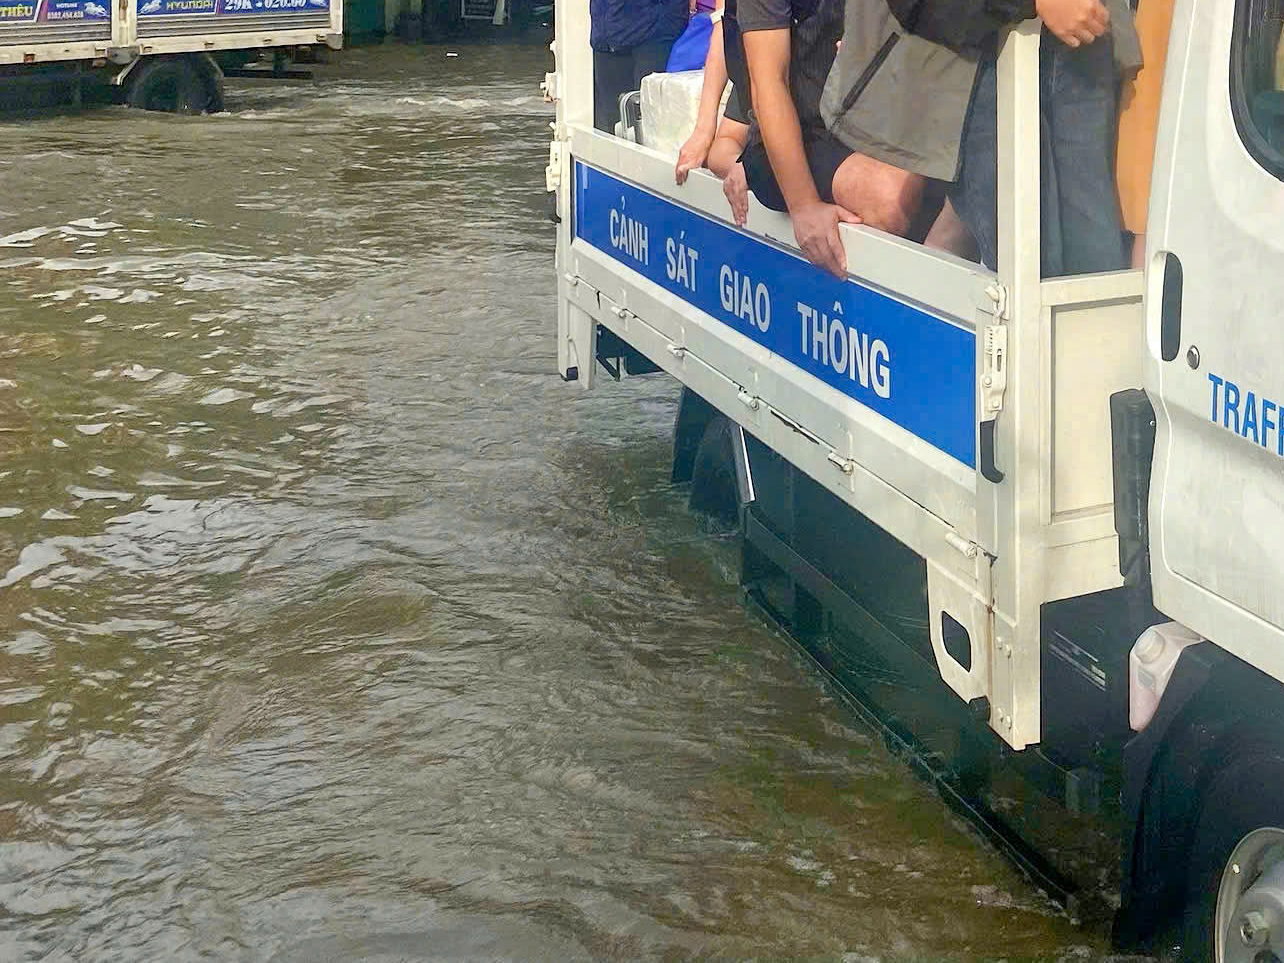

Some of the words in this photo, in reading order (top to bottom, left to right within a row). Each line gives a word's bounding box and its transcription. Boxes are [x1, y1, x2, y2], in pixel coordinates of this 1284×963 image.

[609, 196, 649, 266] CẢNH
[666, 231, 699, 294] SÁT
[719, 264, 771, 333] GIAO
[797, 301, 890, 399] THÔNG
